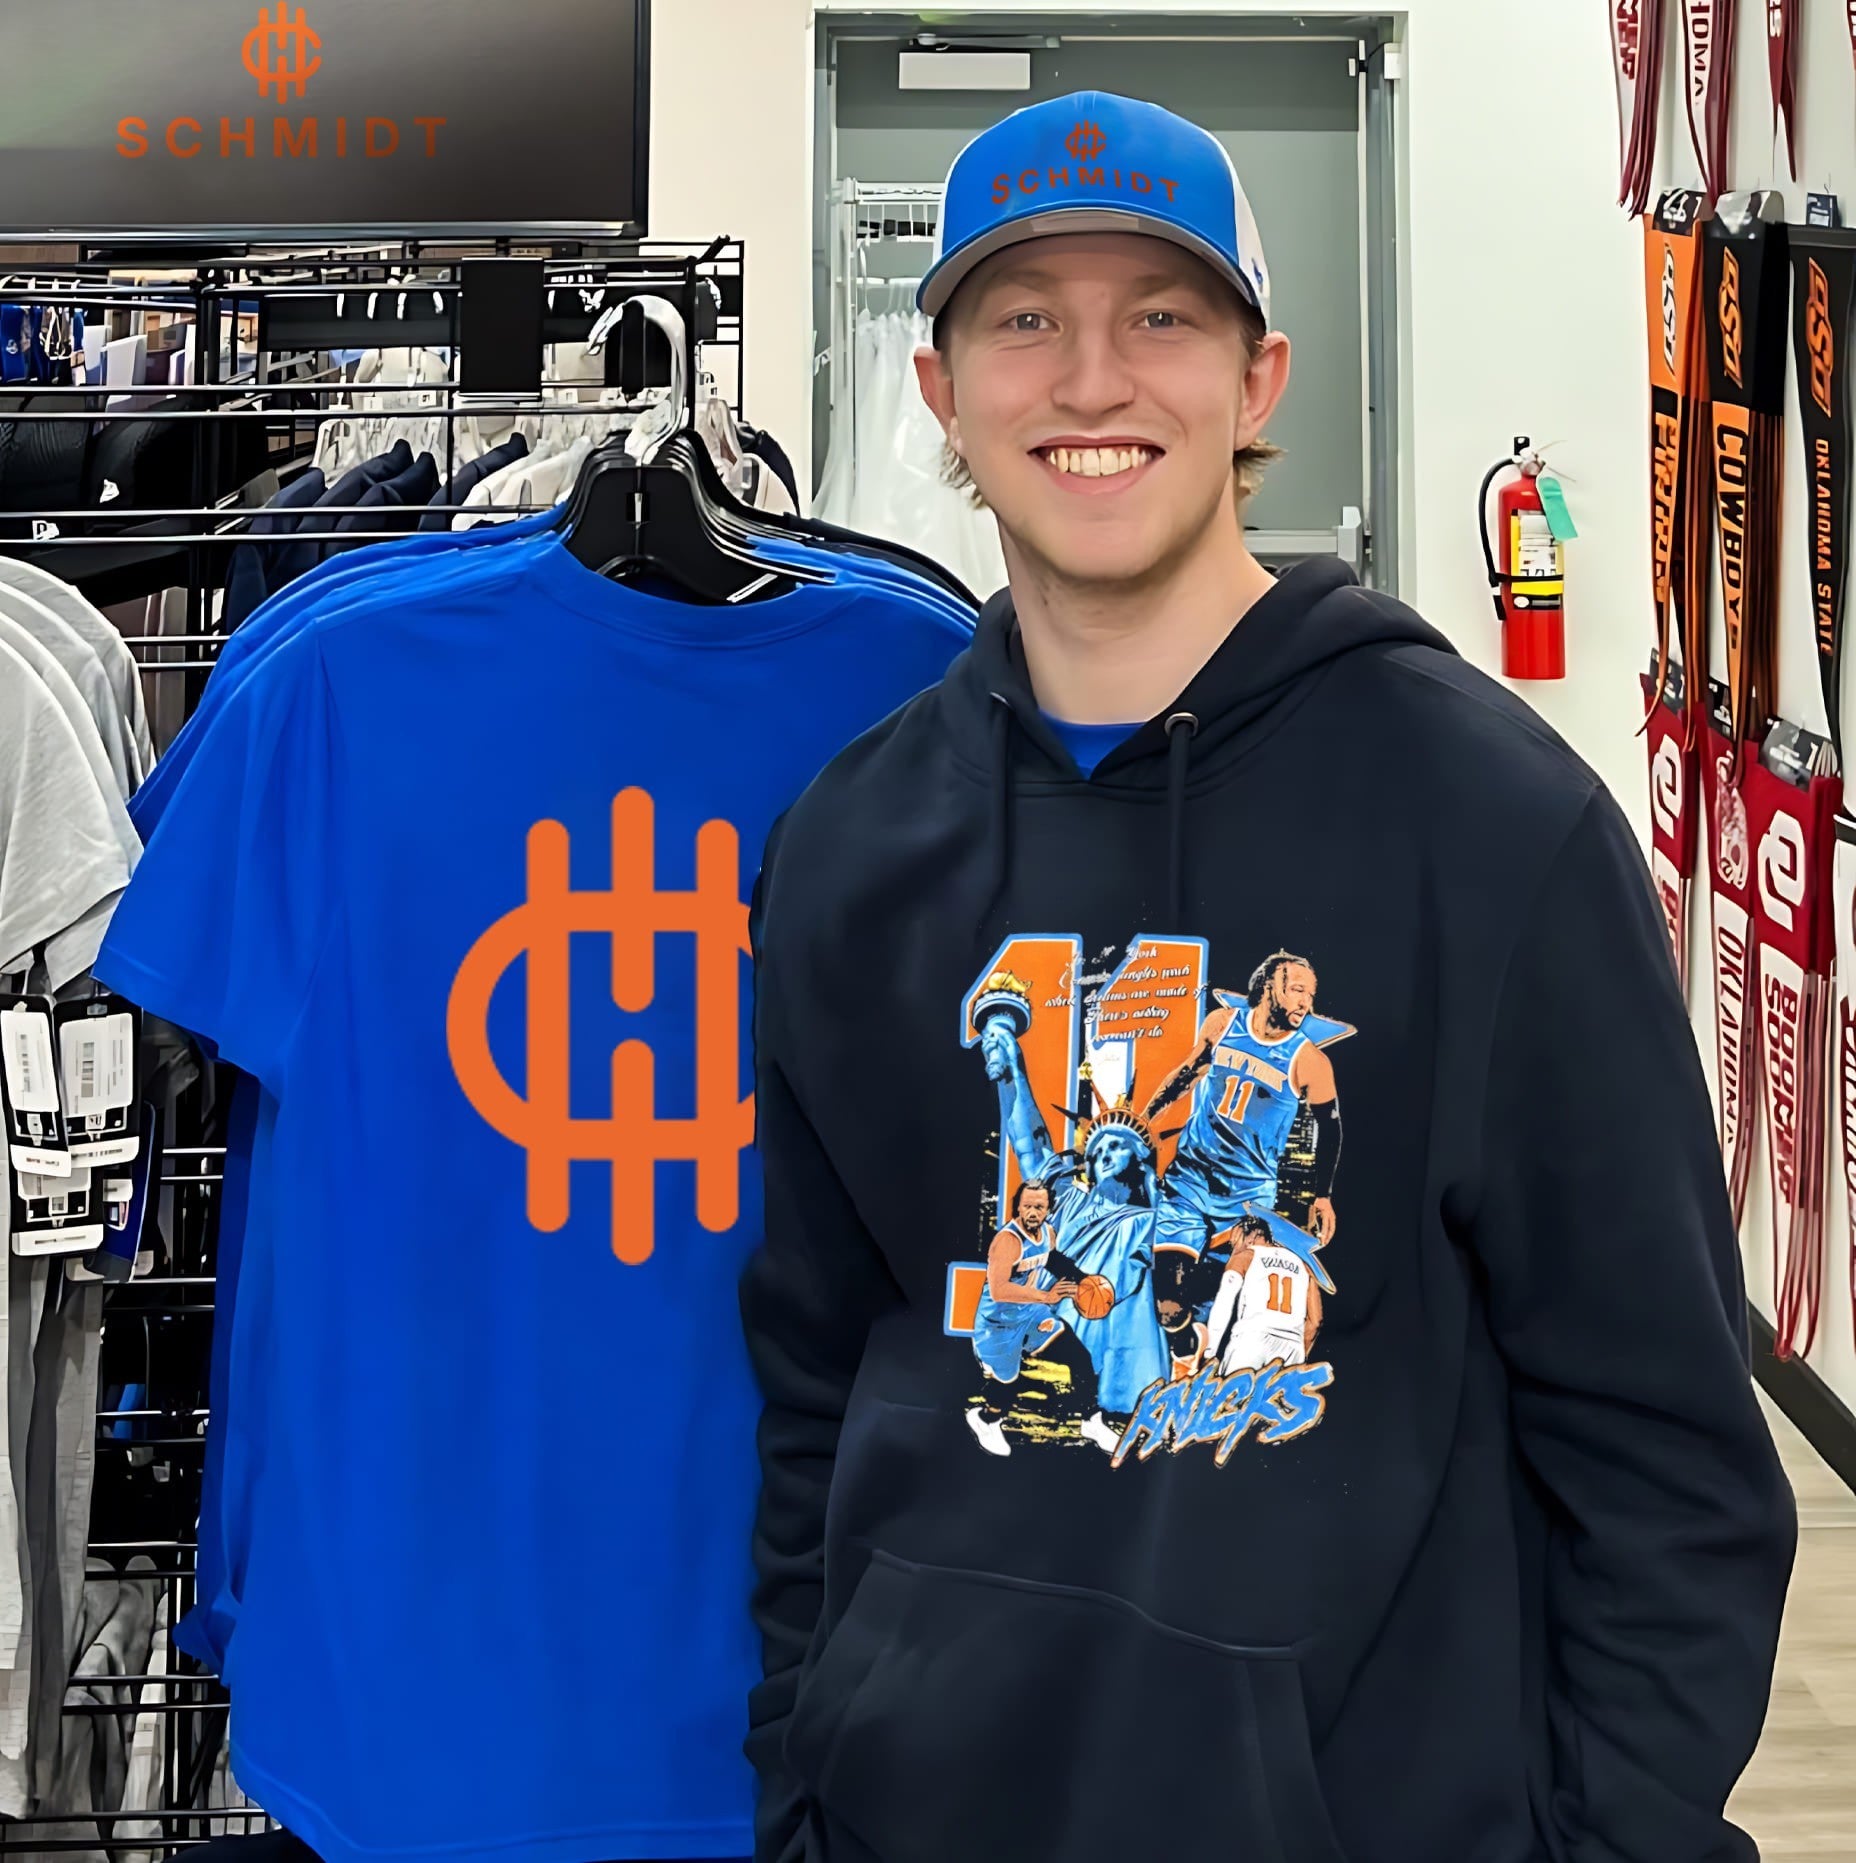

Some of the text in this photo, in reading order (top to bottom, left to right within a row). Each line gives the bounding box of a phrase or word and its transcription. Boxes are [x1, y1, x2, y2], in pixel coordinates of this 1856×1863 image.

[117, 116, 447, 158] SCHMIDT
[991, 166, 1180, 205] SCHMIDT
[1217, 1075, 1256, 1125] 11
[1266, 1272, 1293, 1315] 11
[1110, 1357, 1335, 1469] KNICKS
